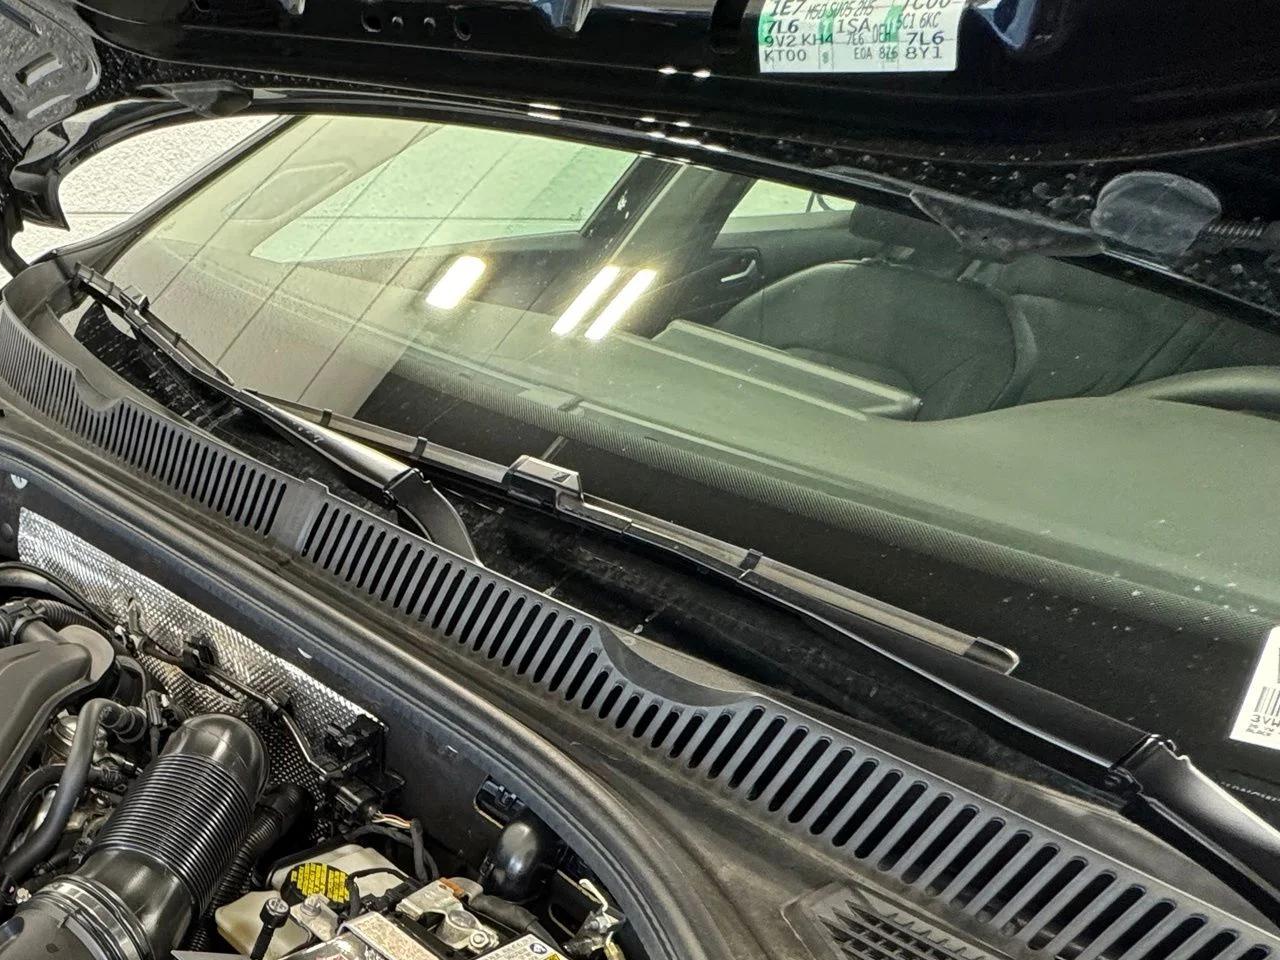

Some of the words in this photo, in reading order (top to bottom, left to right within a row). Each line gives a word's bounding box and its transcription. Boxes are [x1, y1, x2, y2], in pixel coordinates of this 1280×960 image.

[766, 20, 799, 34] 7L6
[836, 18, 871, 34] 1SA
[764, 35, 796, 47] 9V2
[801, 33, 833, 45] KH4
[906, 31, 945, 46] 7L6
[905, 46, 943, 59] 8Y1
